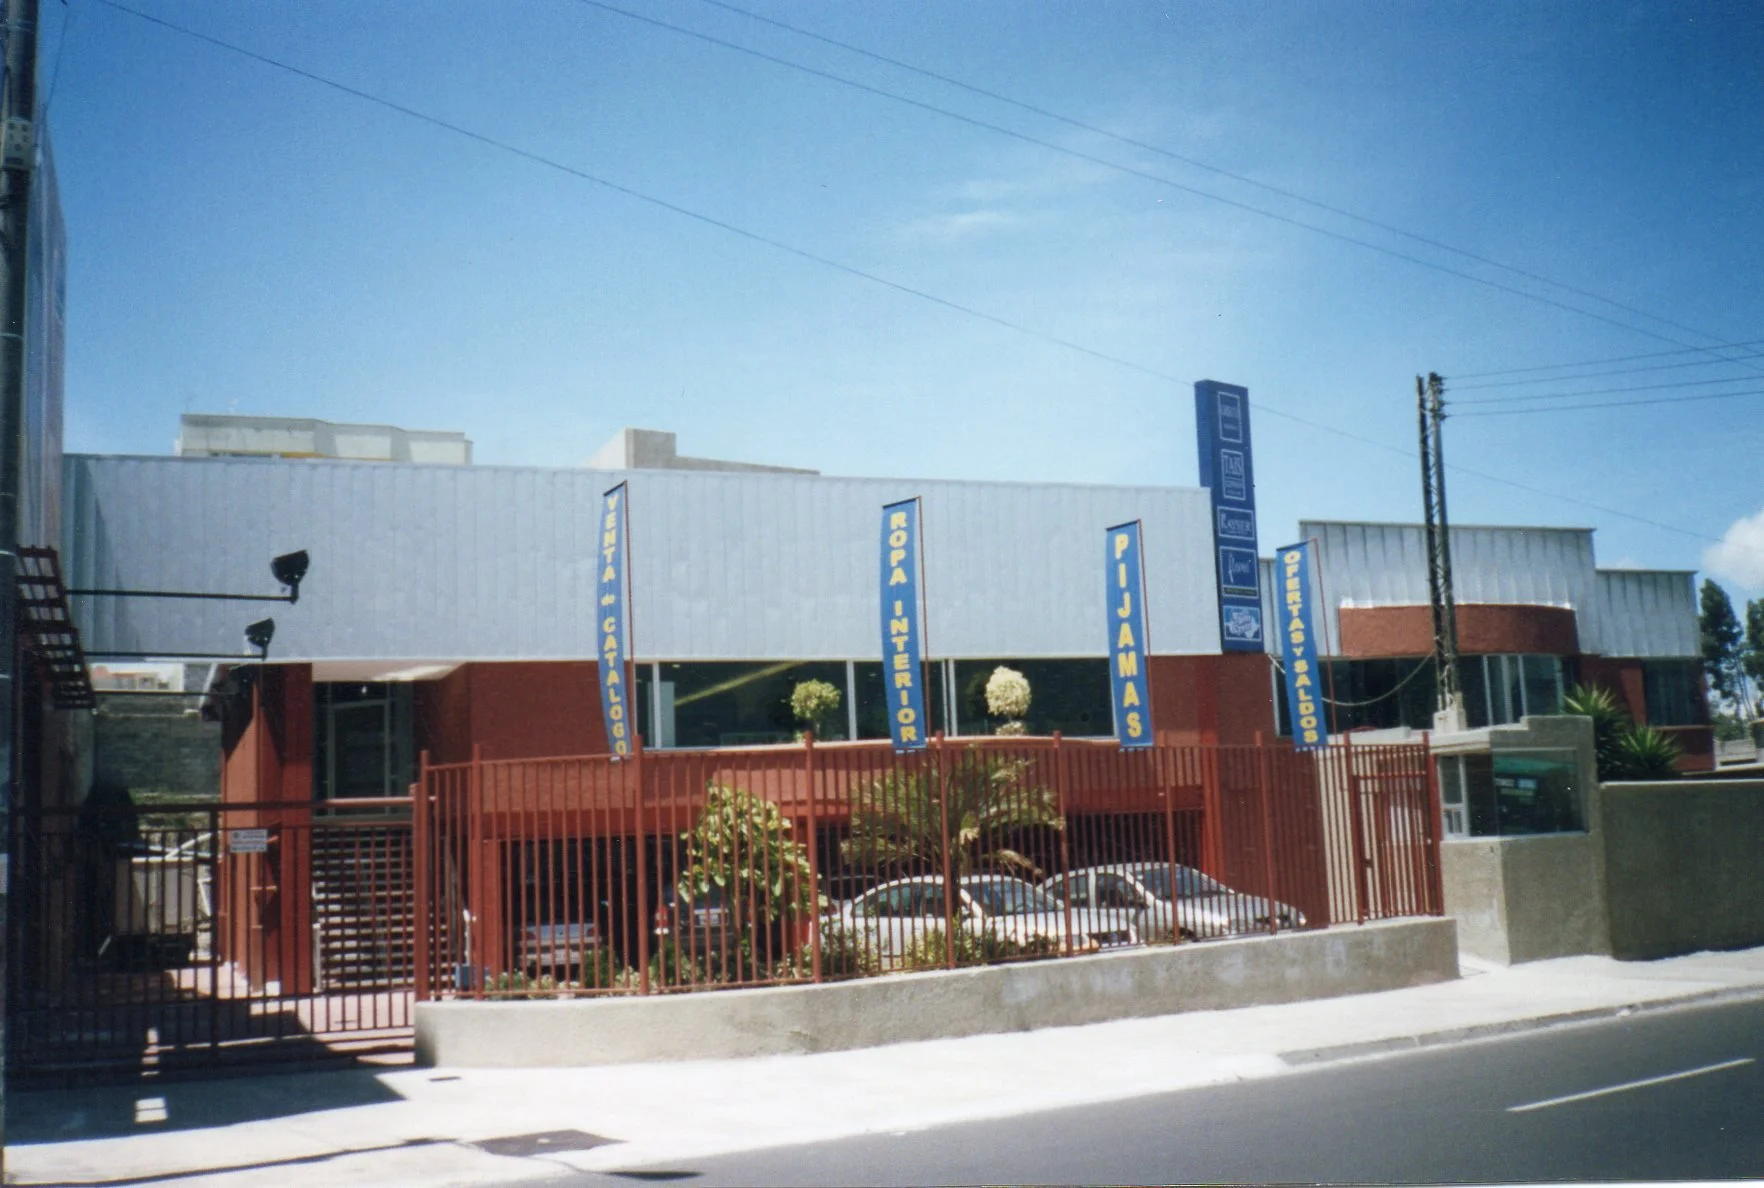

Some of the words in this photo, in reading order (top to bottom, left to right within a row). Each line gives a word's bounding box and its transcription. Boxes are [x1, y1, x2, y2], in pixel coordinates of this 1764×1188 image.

[602, 494, 619, 583] VENTA
[889, 511, 908, 586] ROPA
[1114, 533, 1143, 738] PIJAMAS
[1284, 550, 1305, 644] OFERTAS
[603, 616, 627, 756] CATALOGO
[890, 600, 917, 742] INTERIOR
[1294, 659, 1319, 743] SALDOS
